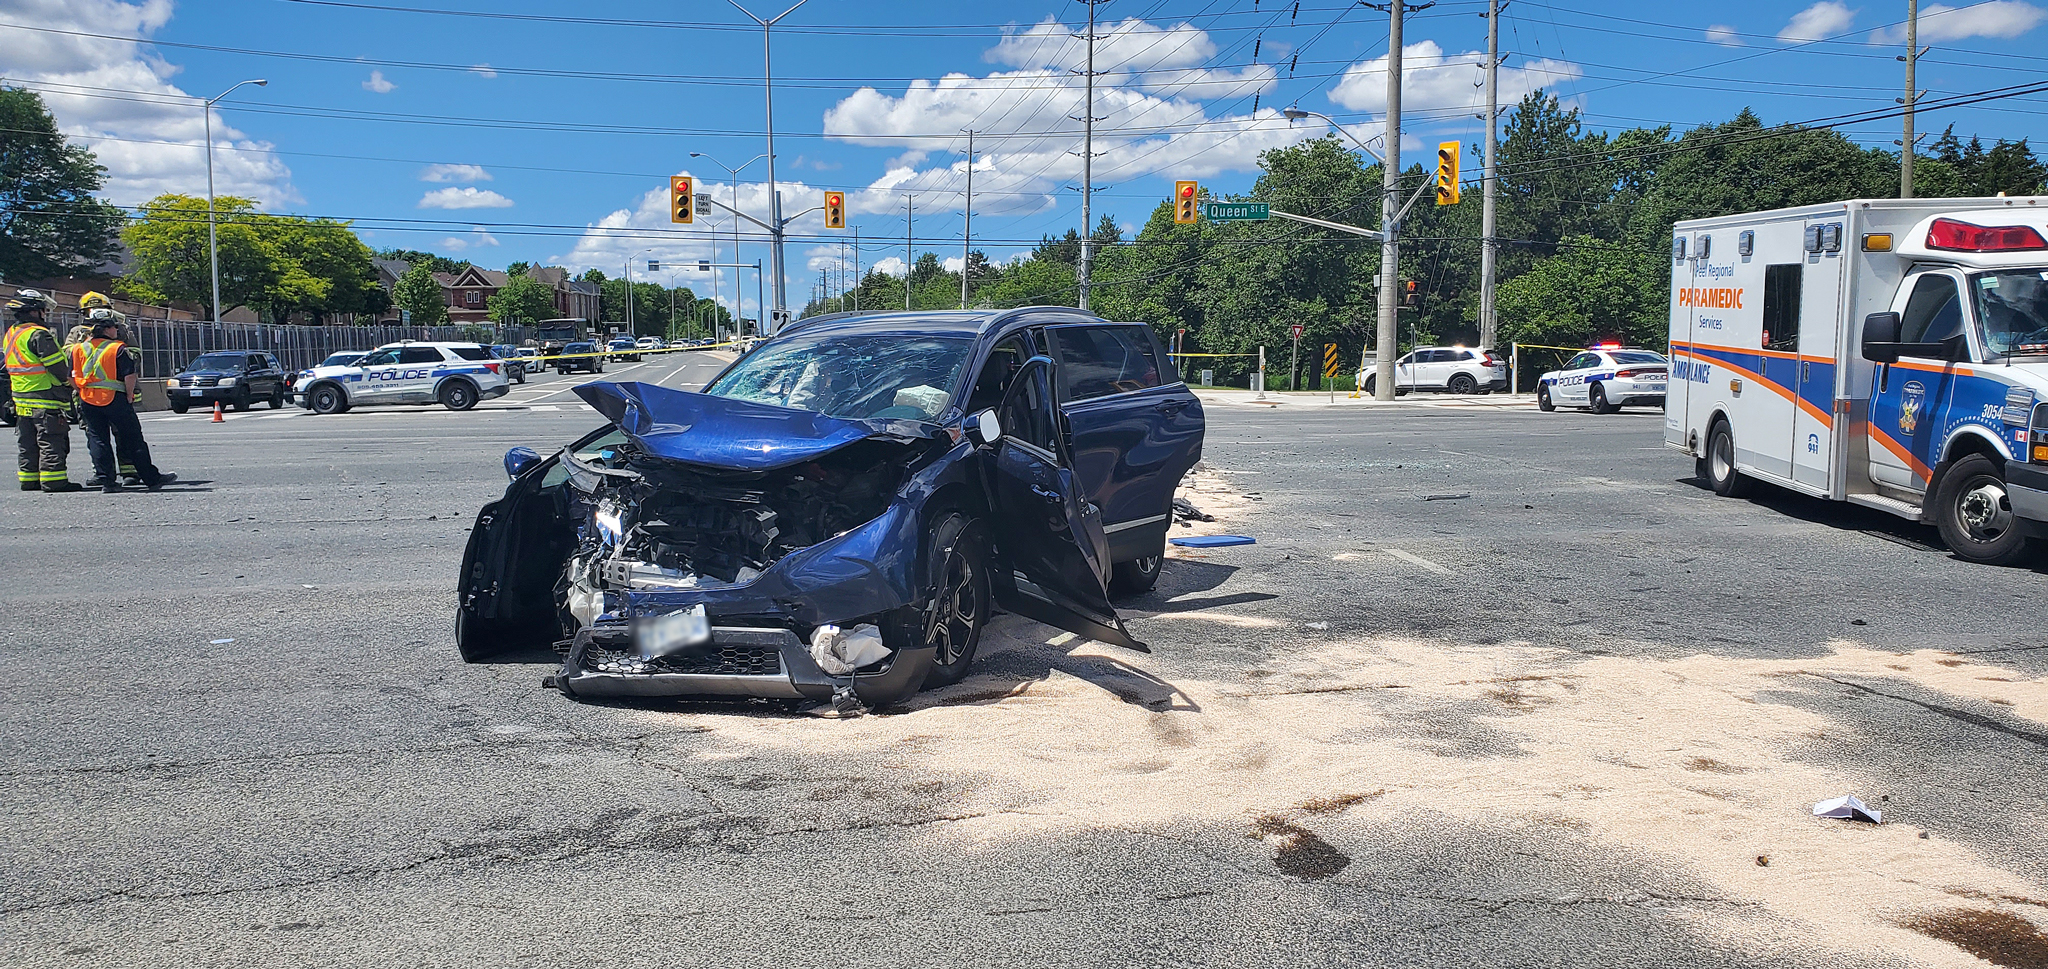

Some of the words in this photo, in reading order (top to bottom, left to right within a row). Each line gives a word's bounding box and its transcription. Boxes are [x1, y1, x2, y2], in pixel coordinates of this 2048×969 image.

[1211, 205, 1247, 217] Queen
[1250, 205, 1258, 213] St
[1260, 205, 1265, 213] E
[1695, 262, 1707, 278] Peel
[1708, 262, 1734, 281] Regional
[1679, 288, 1743, 309] PARAMEDIC
[1699, 315, 1723, 330] Services
[368, 370, 429, 382] POLICE
[1672, 360, 1711, 384] AMBULANCE
[1559, 375, 1584, 388] POLICE
[1982, 403, 2005, 420] 3054
[1808, 443, 1819, 455] 911
